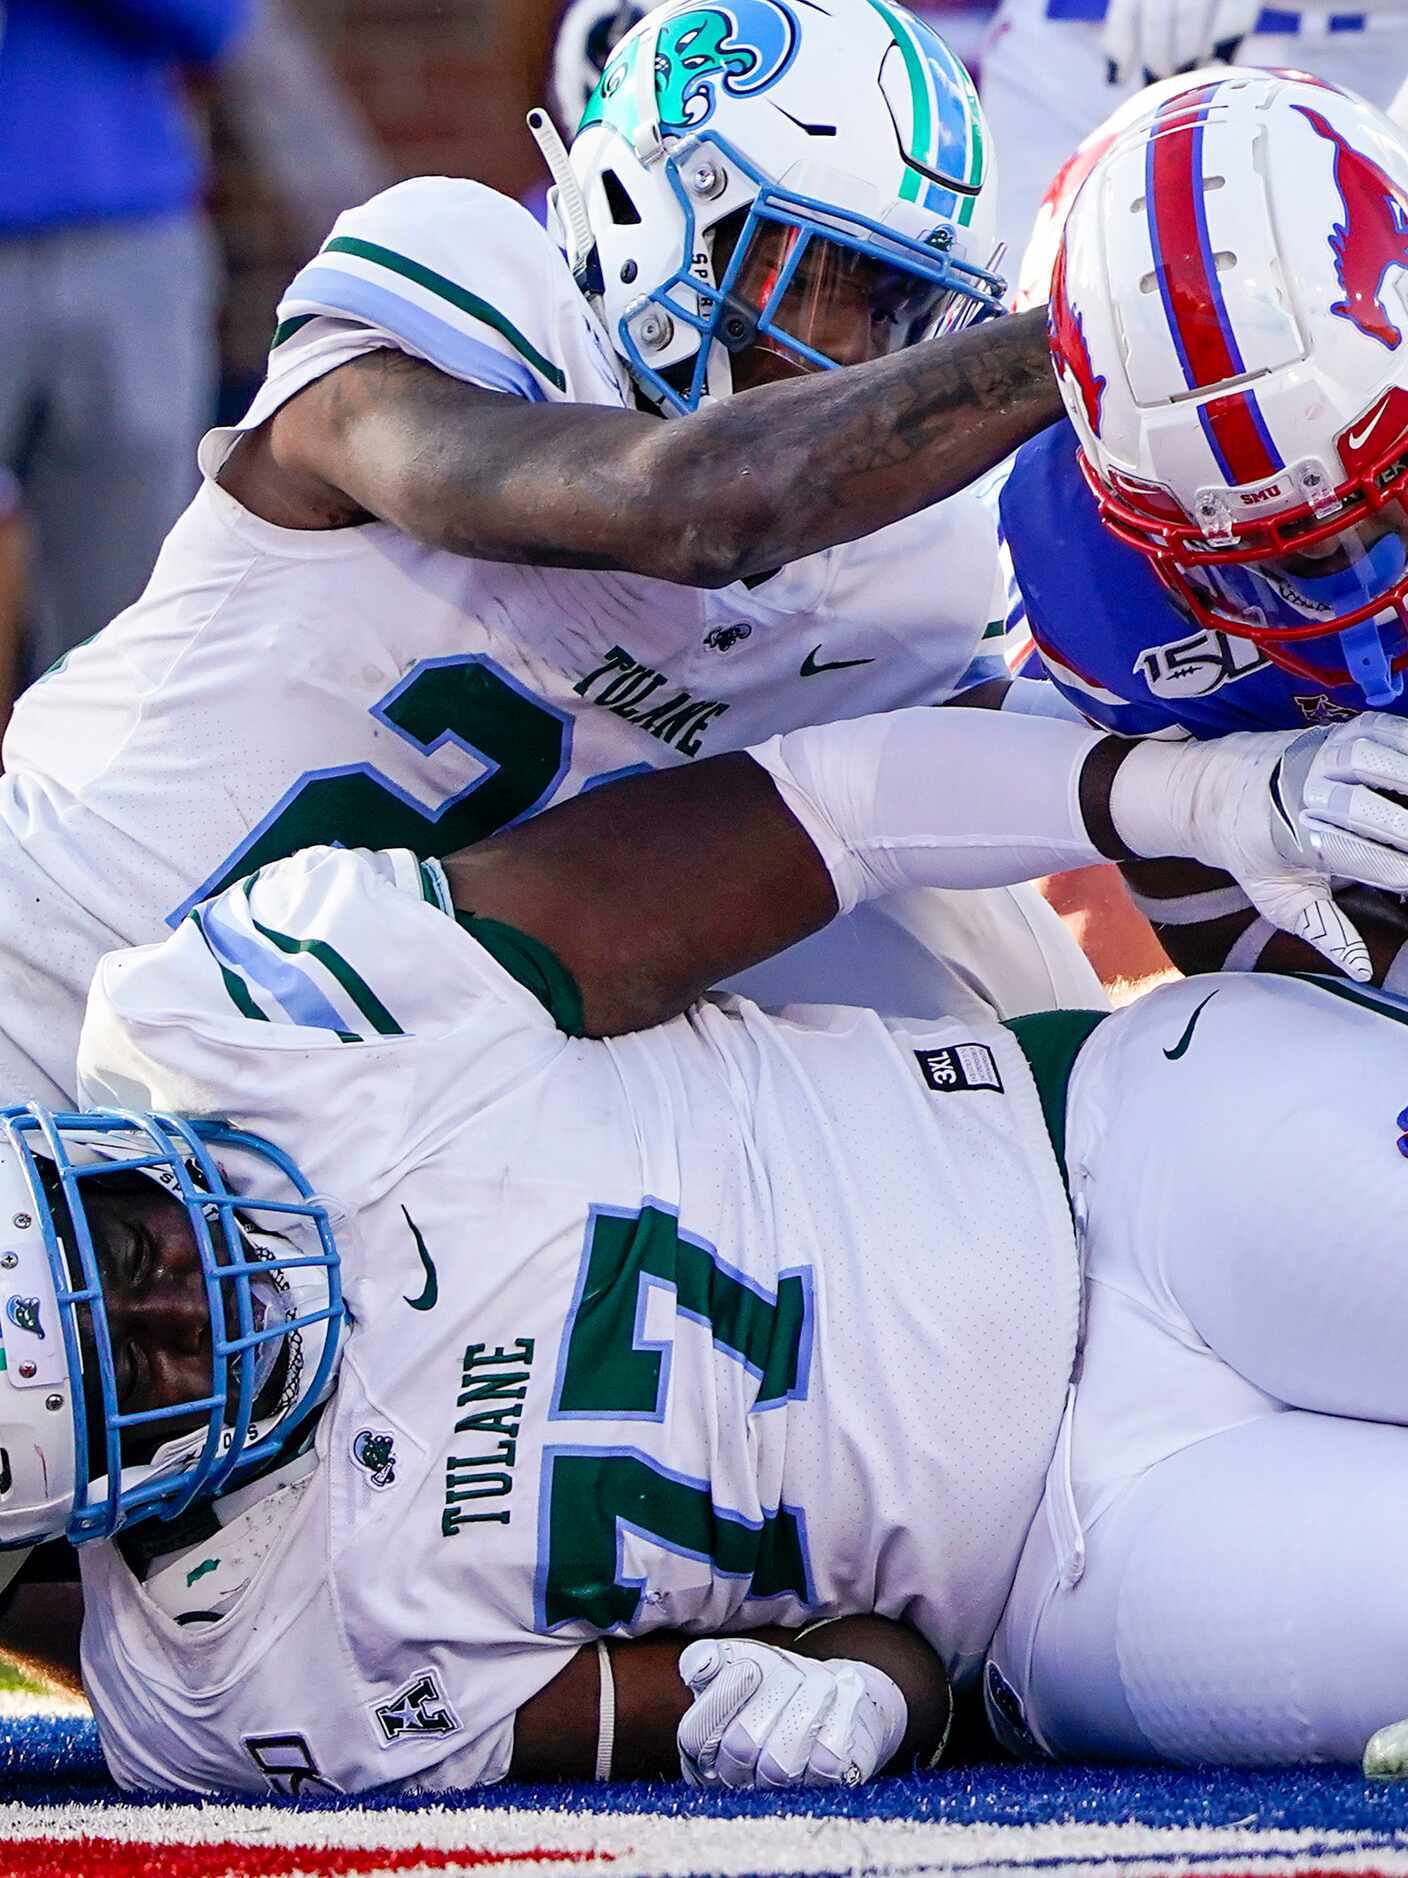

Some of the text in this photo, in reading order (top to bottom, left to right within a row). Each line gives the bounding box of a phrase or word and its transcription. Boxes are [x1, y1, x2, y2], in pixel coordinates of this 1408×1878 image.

[1240, 485, 1281, 504] SMU
[573, 645, 730, 758] TULANE
[927, 1050, 957, 1084] 3XL
[442, 1337, 535, 1537] TULANE
[534, 1195, 816, 1634] 77
